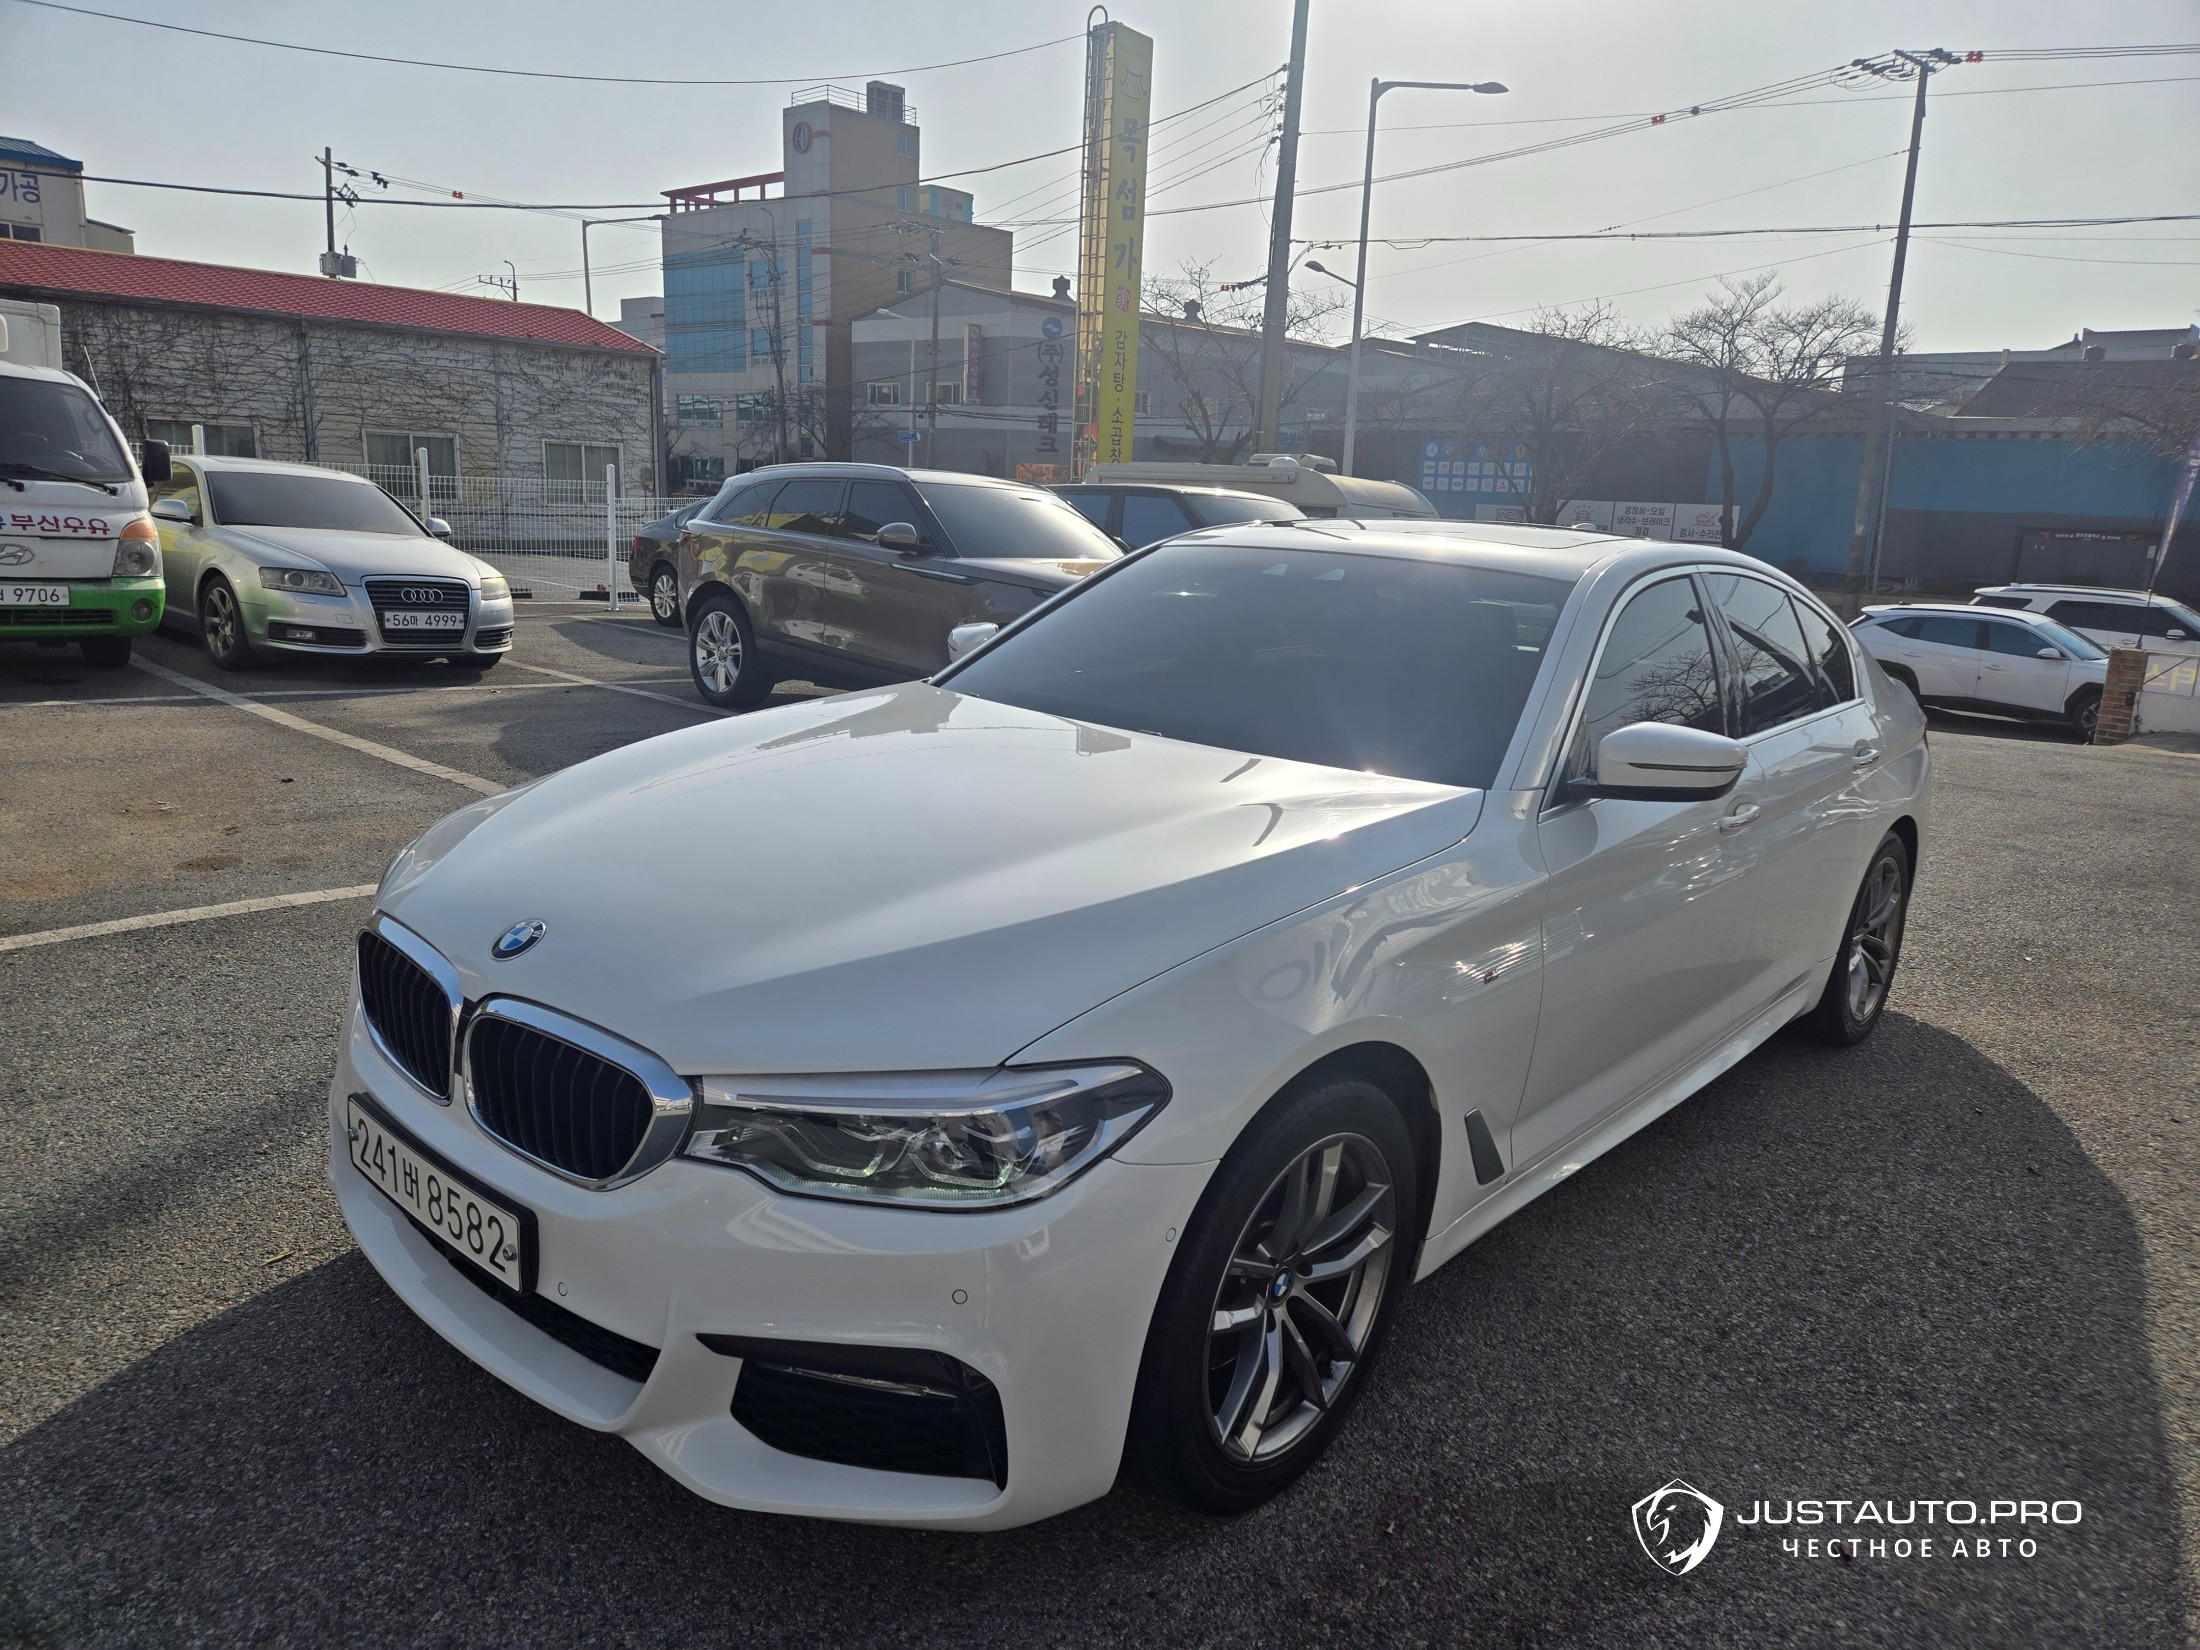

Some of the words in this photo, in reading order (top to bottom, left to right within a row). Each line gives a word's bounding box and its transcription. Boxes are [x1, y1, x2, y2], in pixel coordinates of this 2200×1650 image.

[11, 514, 110, 535] 부산우유
[14, 588, 60, 602] 9706
[425, 615, 457, 627] 4999
[427, 1174, 506, 1273] 8582
